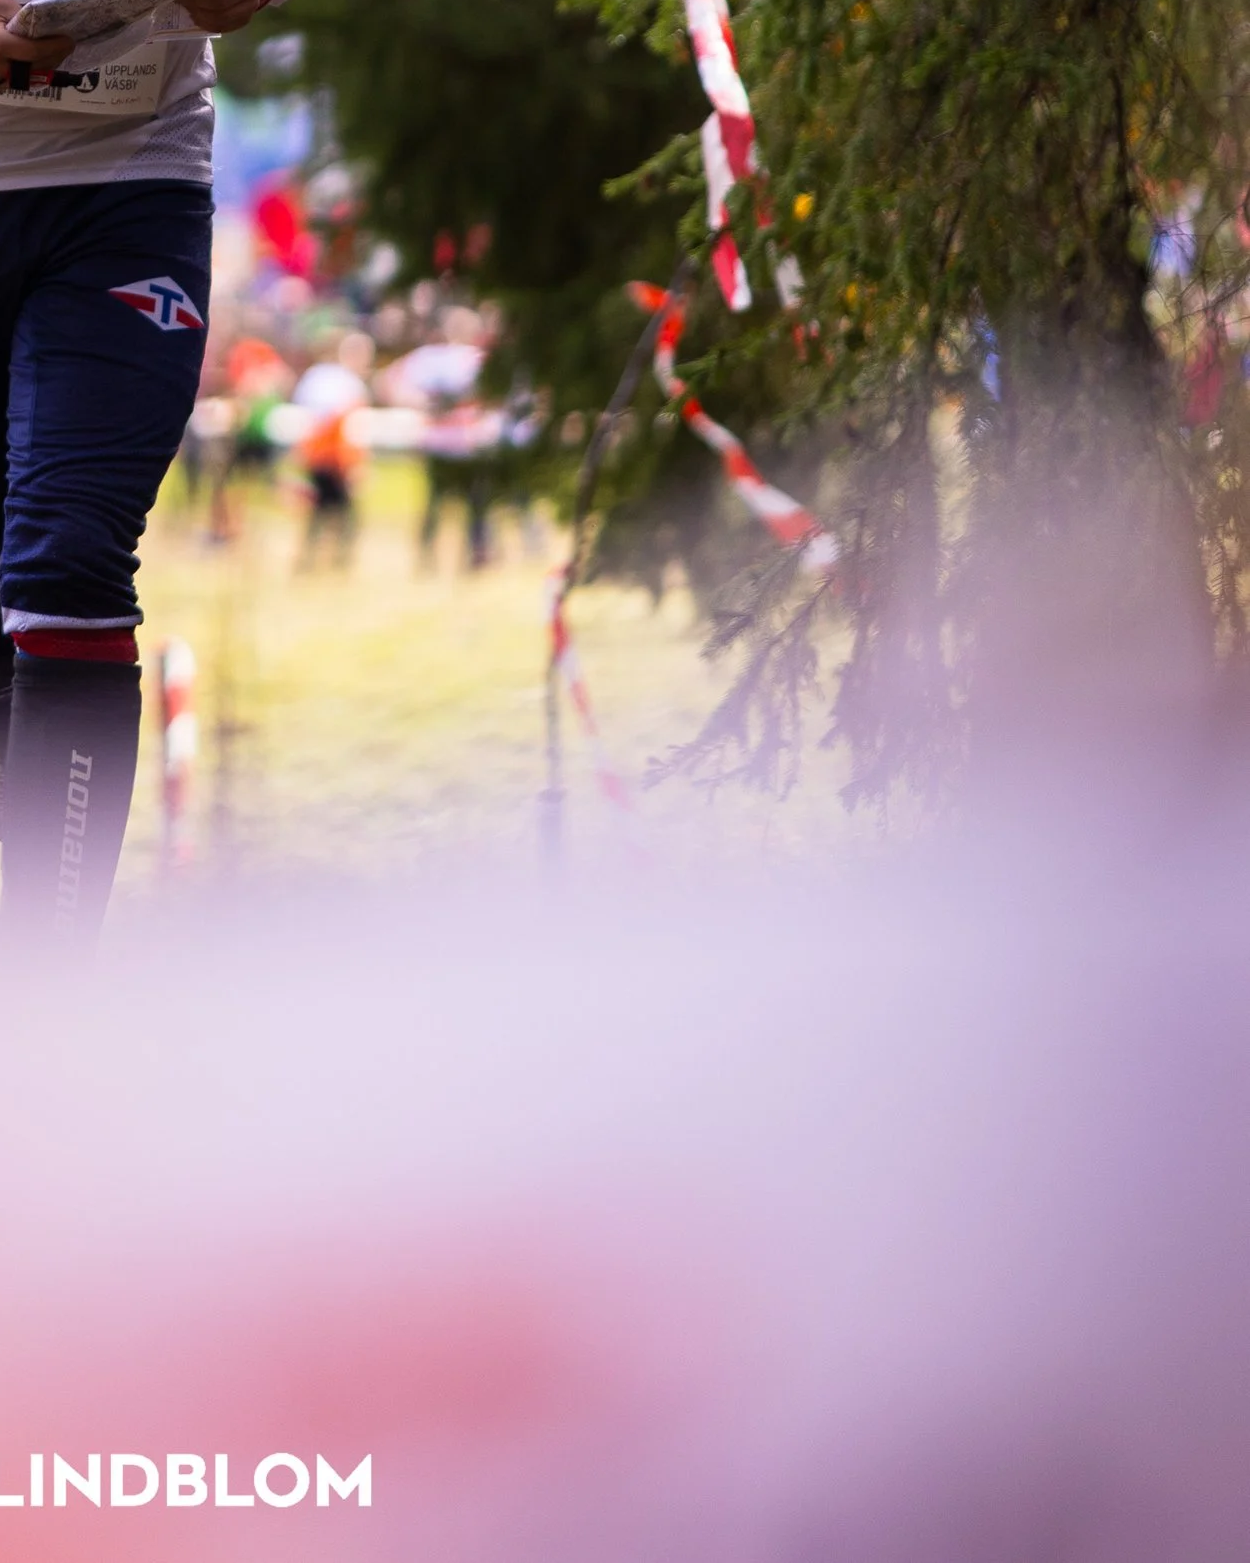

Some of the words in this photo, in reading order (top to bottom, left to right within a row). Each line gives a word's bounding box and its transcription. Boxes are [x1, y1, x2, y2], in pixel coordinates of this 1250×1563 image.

[105, 64, 157, 76] UPPLANDS
[104, 77, 138, 90] VÄSBY
[150, 283, 184, 325] T
